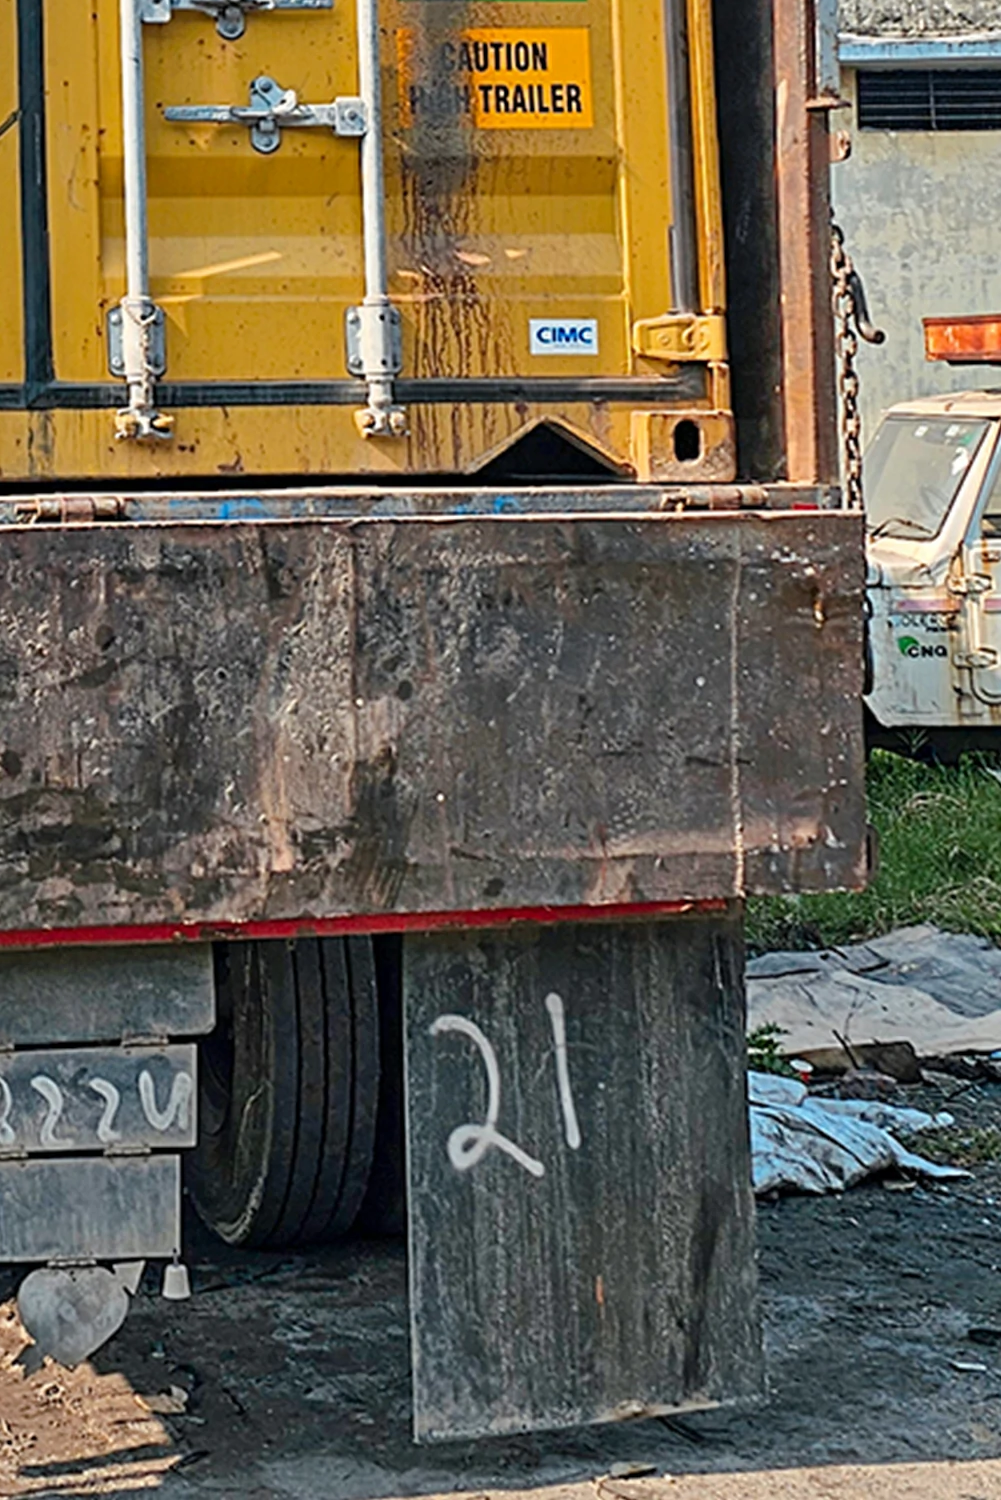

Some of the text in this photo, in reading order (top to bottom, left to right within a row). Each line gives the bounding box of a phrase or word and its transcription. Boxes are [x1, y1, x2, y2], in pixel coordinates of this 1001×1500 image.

[442, 40, 549, 73] CAUTION
[477, 83, 583, 114] TRAILER
[535, 325, 593, 345] CIMC
[907, 644, 948, 658] CNG
[429, 992, 582, 1178] 21
